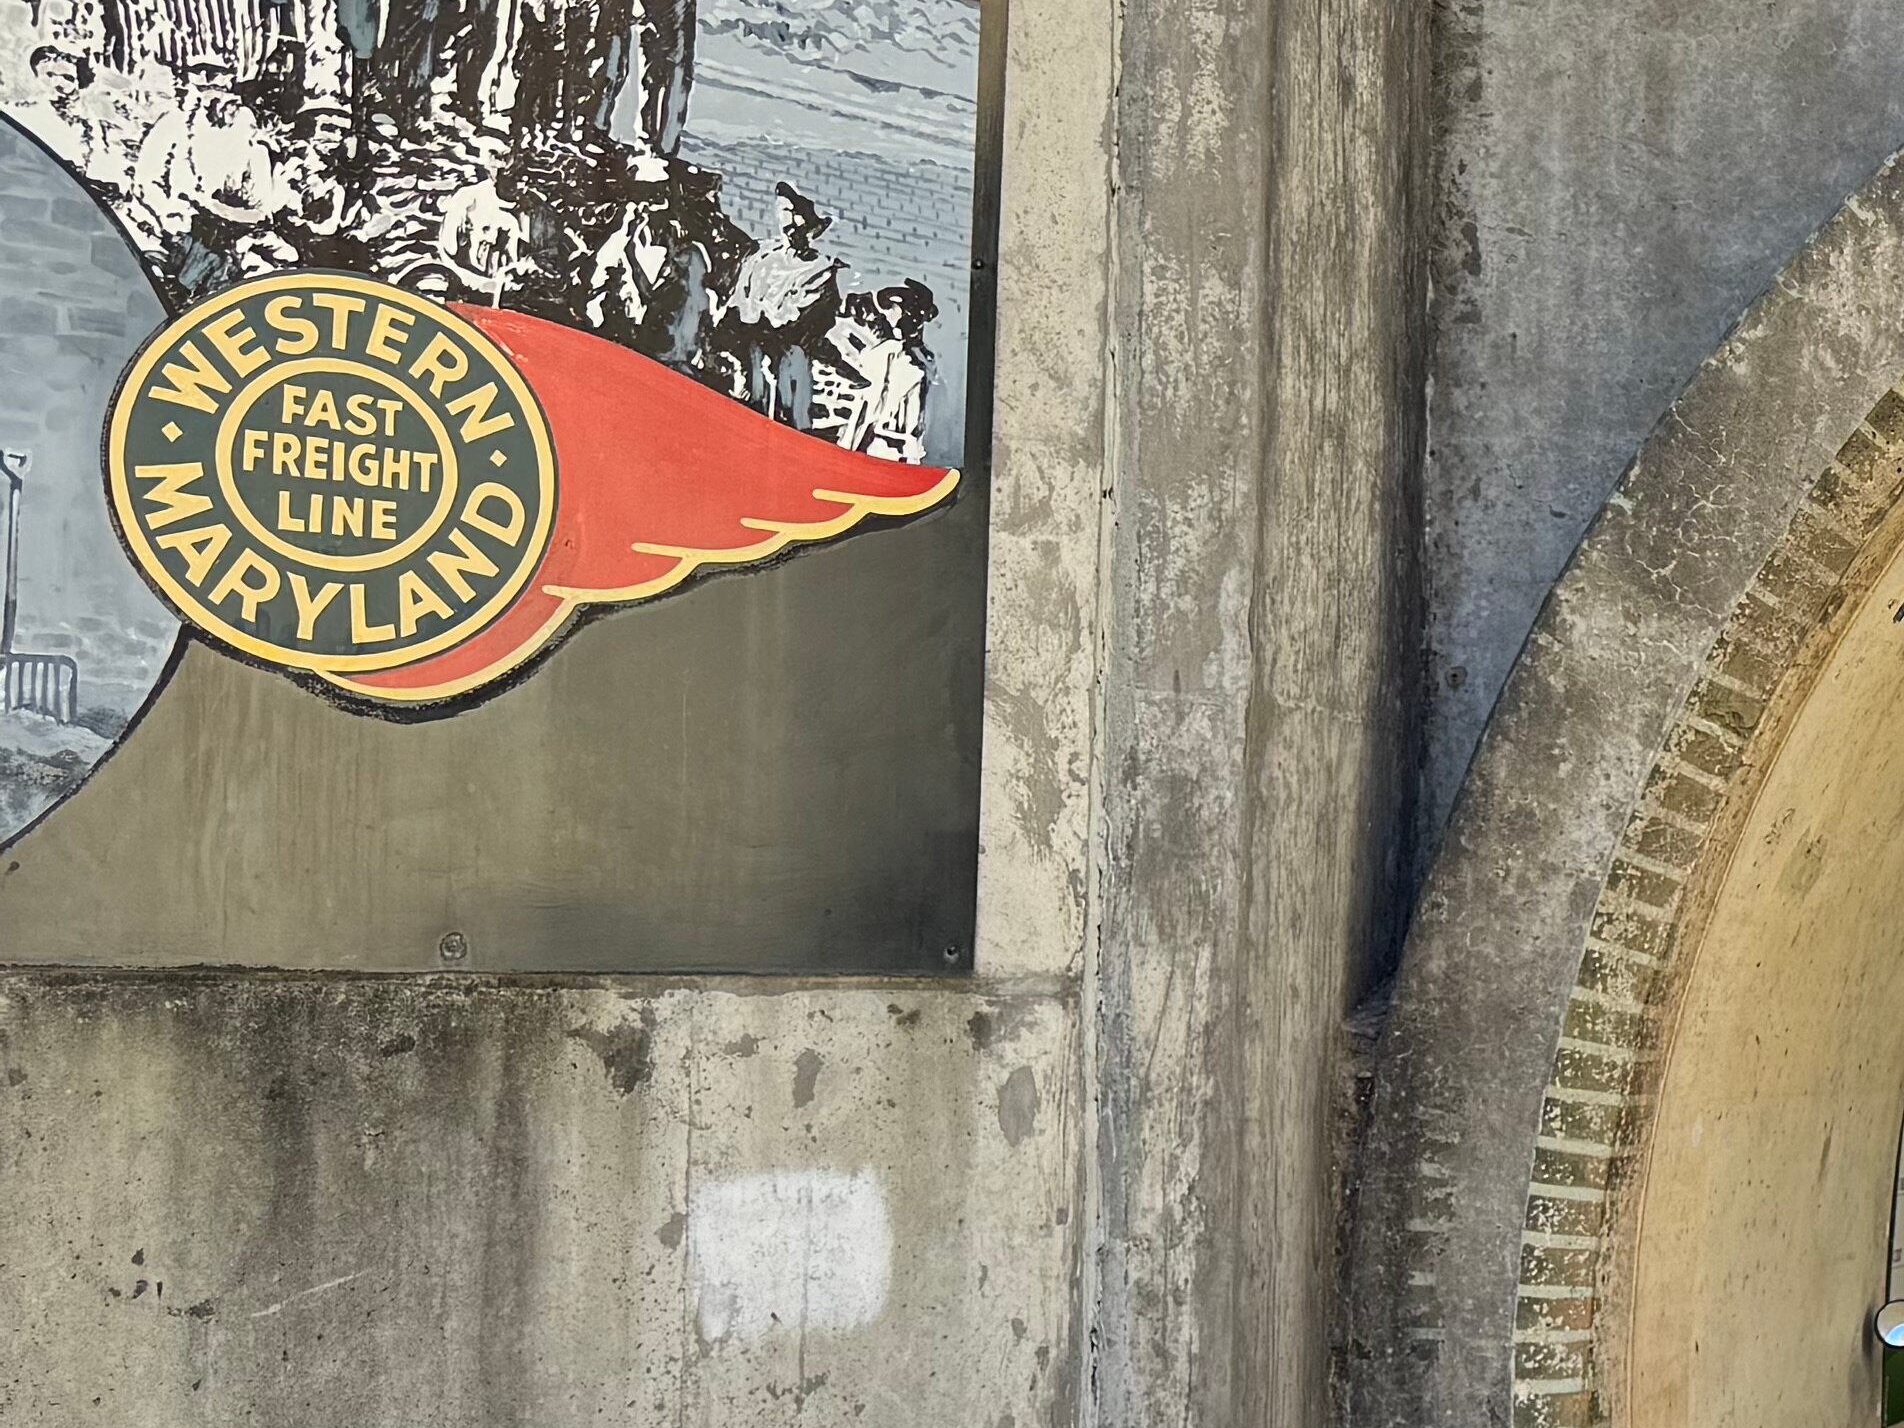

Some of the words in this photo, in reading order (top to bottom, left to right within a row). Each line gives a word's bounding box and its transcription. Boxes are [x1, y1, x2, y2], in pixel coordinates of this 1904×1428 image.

[148, 292, 516, 445] WESTERN
[281, 383, 404, 438] FAST
[242, 428, 439, 493] FREIGHT
[277, 490, 398, 540] LINE
[134, 461, 526, 645] MARYLAND
